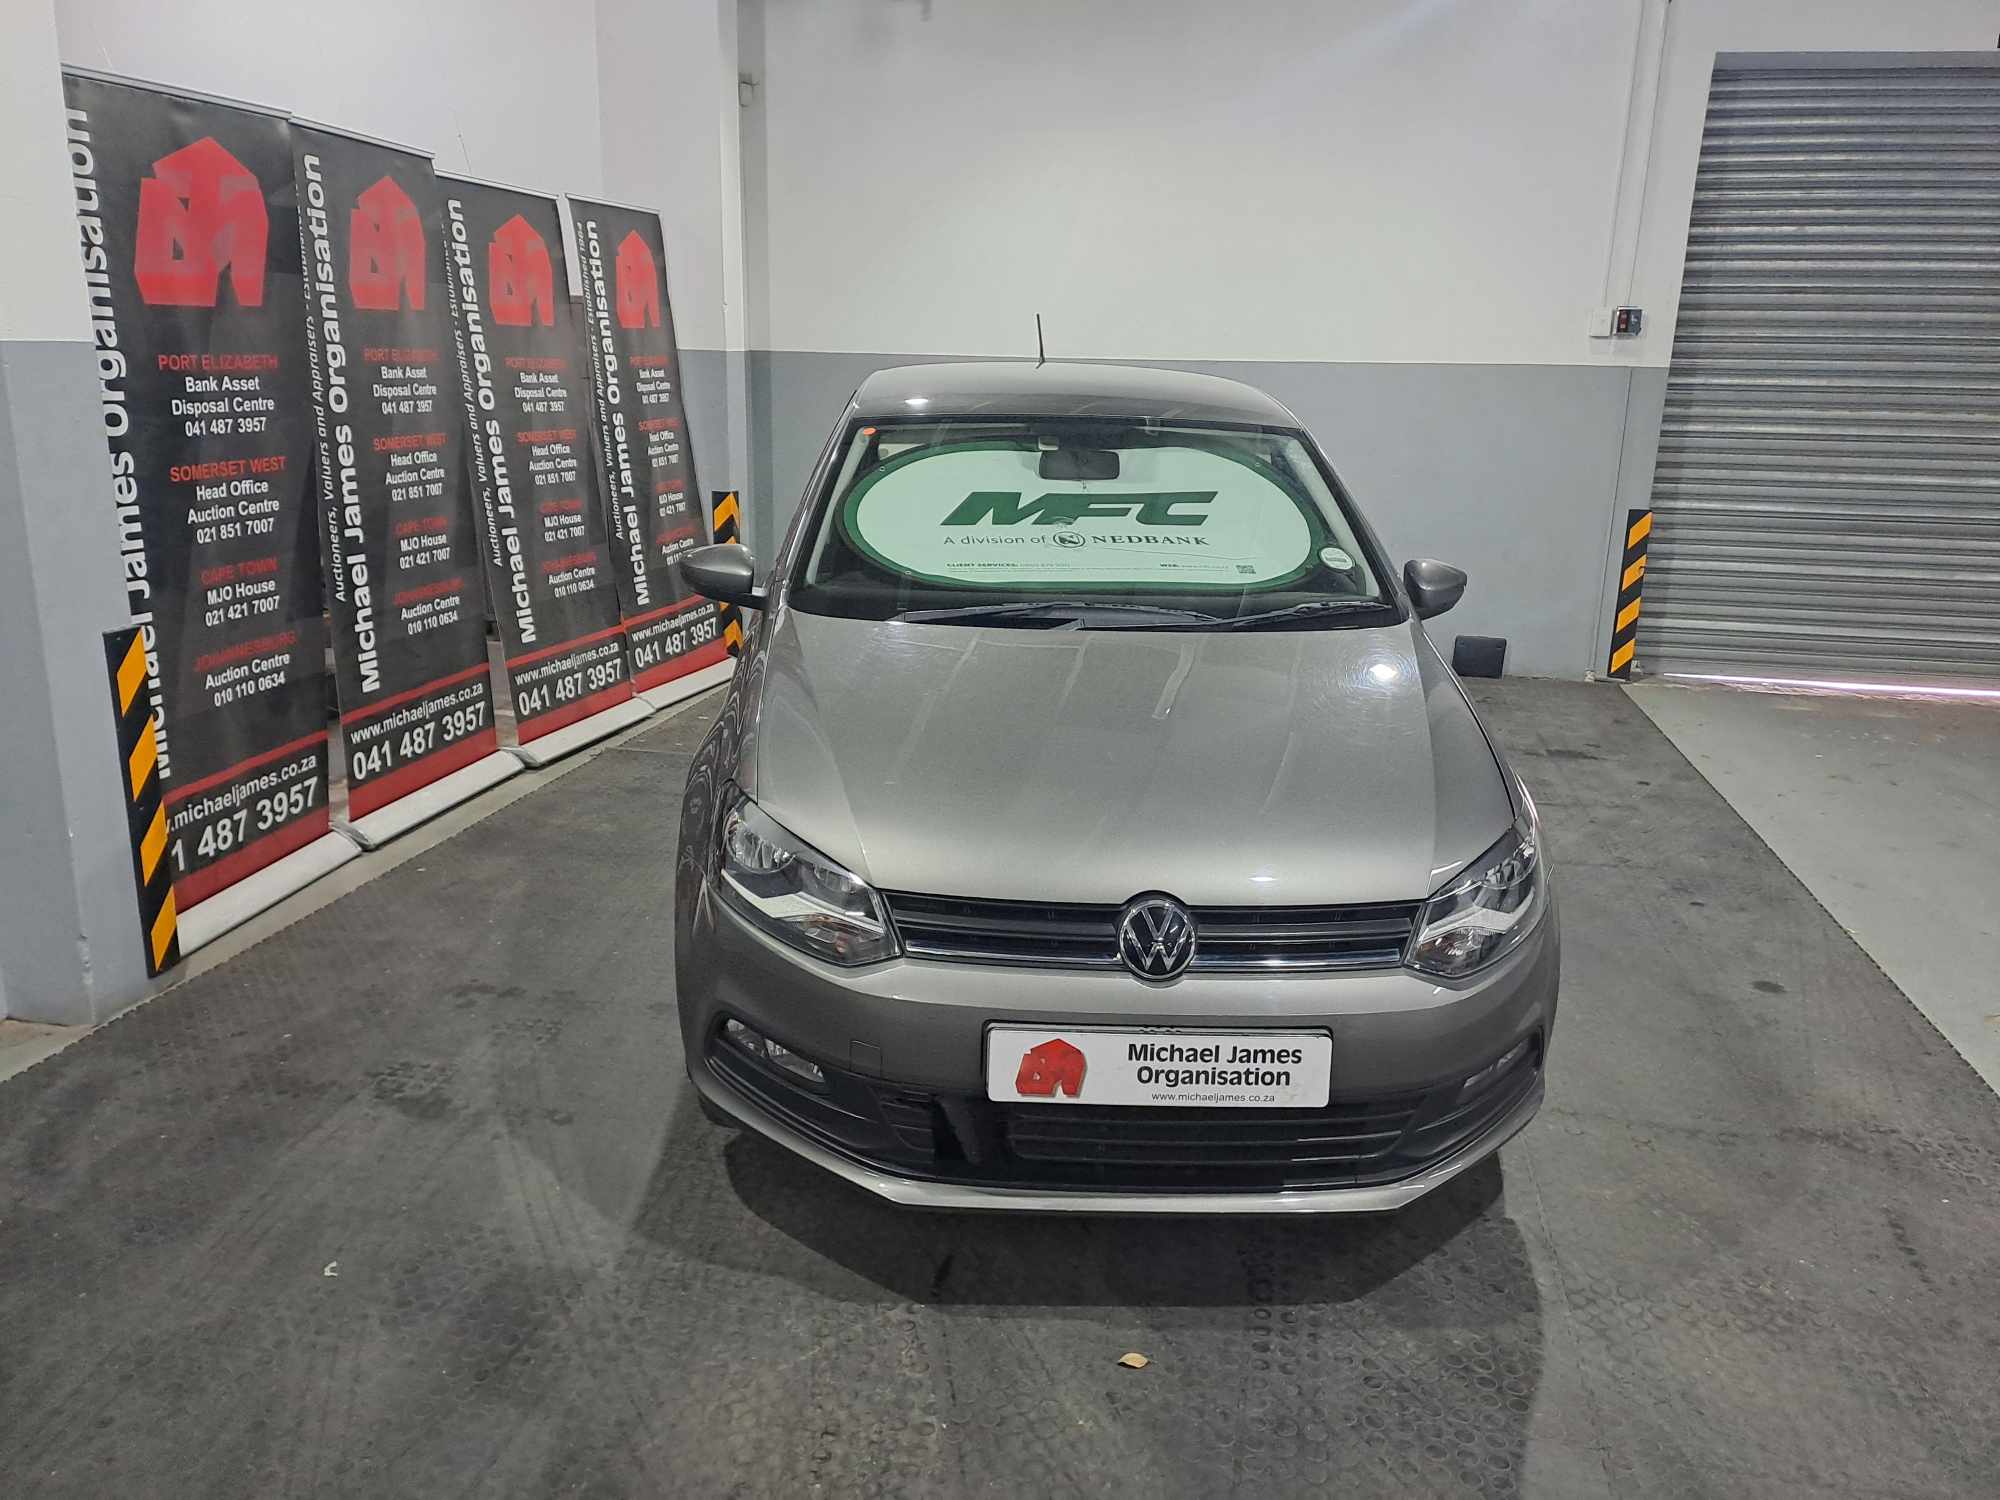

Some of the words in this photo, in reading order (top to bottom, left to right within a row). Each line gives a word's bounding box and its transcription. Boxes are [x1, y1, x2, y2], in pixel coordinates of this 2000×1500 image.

[303, 154, 348, 413] Organisation
[447, 199, 495, 411] Organisation
[586, 220, 620, 405] Organisation
[158, 355, 198, 370] PORT
[202, 354, 278, 370] ELIZABETH
[305, 315, 325, 402] Appraisers
[454, 329, 474, 402] Appraisers
[185, 376, 218, 392] Bank
[221, 376, 260, 391] Asset
[381, 366, 403, 379] Bank
[405, 366, 428, 378] Asset
[520, 372, 538, 383] Bank
[373, 384, 411, 399] Disposal
[412, 383, 437, 396] Centre
[514, 387, 544, 399] Disposal
[172, 398, 229, 418] Disposal
[233, 397, 275, 412] Centre
[382, 402, 397, 415] 041
[399, 401, 414, 413] 487
[416, 400, 432, 413] 3957
[465, 404, 478, 430] and
[598, 399, 607, 422] and
[185, 420, 206, 437] 041
[210, 419, 233, 434] 487
[238, 417, 267, 432] 3957
[313, 406, 327, 438] and
[390, 453, 412, 467] Head
[414, 451, 438, 464] Office
[472, 433, 488, 482] Valuers
[602, 425, 613, 467] Valuers
[612, 412, 634, 498] James
[170, 460, 246, 482] SOMERSET
[250, 456, 287, 473] WEST
[320, 441, 335, 500] Valuers
[385, 471, 418, 485] Auction
[420, 468, 445, 481] Centre
[486, 419, 515, 519] James
[529, 460, 554, 471] Auction
[196, 483, 227, 501] Head
[230, 480, 269, 497] Office
[335, 424, 364, 543] James
[392, 489, 406, 502] 021
[408, 486, 423, 499] 851
[426, 483, 443, 496] 7007
[187, 504, 234, 524] Auction
[238, 499, 280, 516] Centre
[560, 514, 582, 525] House
[940, 491, 1219, 526] MFC
[197, 527, 216, 544] 021
[221, 523, 242, 539] 851
[247, 518, 275, 534] 7007
[484, 487, 503, 567] Auctioneers,
[400, 537, 419, 552] MJO
[421, 534, 447, 547] House
[943, 536, 956, 545] A
[960, 535, 1025, 545] division
[1030, 535, 1047, 544] of
[1092, 535, 1210, 546] NEDBANK
[328, 506, 347, 602] Auctioneers,
[400, 555, 414, 569] 021
[416, 552, 431, 566] 421
[433, 547, 450, 561] 7007
[623, 505, 650, 606] Michael
[501, 527, 537, 644] Michael
[549, 573, 573, 584] Auction
[207, 586, 232, 605] MJO
[236, 579, 276, 598] House
[205, 609, 224, 627] 021
[227, 602, 249, 622] 421
[252, 595, 280, 616] 7007
[401, 603, 433, 620] Auction
[434, 595, 460, 611] Centre
[347, 553, 381, 693] Michael
[408, 619, 422, 635] 010
[424, 615, 437, 630] 110
[439, 610, 458, 626] 0634
[632, 602, 714, 642] www.michaeljames.co.za
[635, 643, 660, 668] 041
[665, 631, 686, 656] 487
[691, 617, 718, 646] 3957
[205, 664, 249, 690] Auction
[252, 652, 291, 675] Centre
[515, 641, 619, 686] www.michaeljames.co.za
[214, 687, 232, 707] 010
[235, 680, 255, 701] 110
[258, 672, 286, 694] 0634
[518, 684, 550, 716] 041
[556, 673, 582, 701] 487
[587, 658, 621, 690] 3957
[350, 681, 484, 744] www.michaeljames.co.za
[353, 740, 392, 780] 041
[399, 721, 436, 759] 487
[442, 701, 486, 741] 3957
[198, 809, 249, 859] 487
[257, 776, 318, 832] 3957
[1128, 1043, 1220, 1063] Michael
[1227, 1046, 1302, 1064] James
[1137, 1066, 1291, 1087] Organisation
[1151, 1092, 1275, 1104] www.michaeljames.co.za
